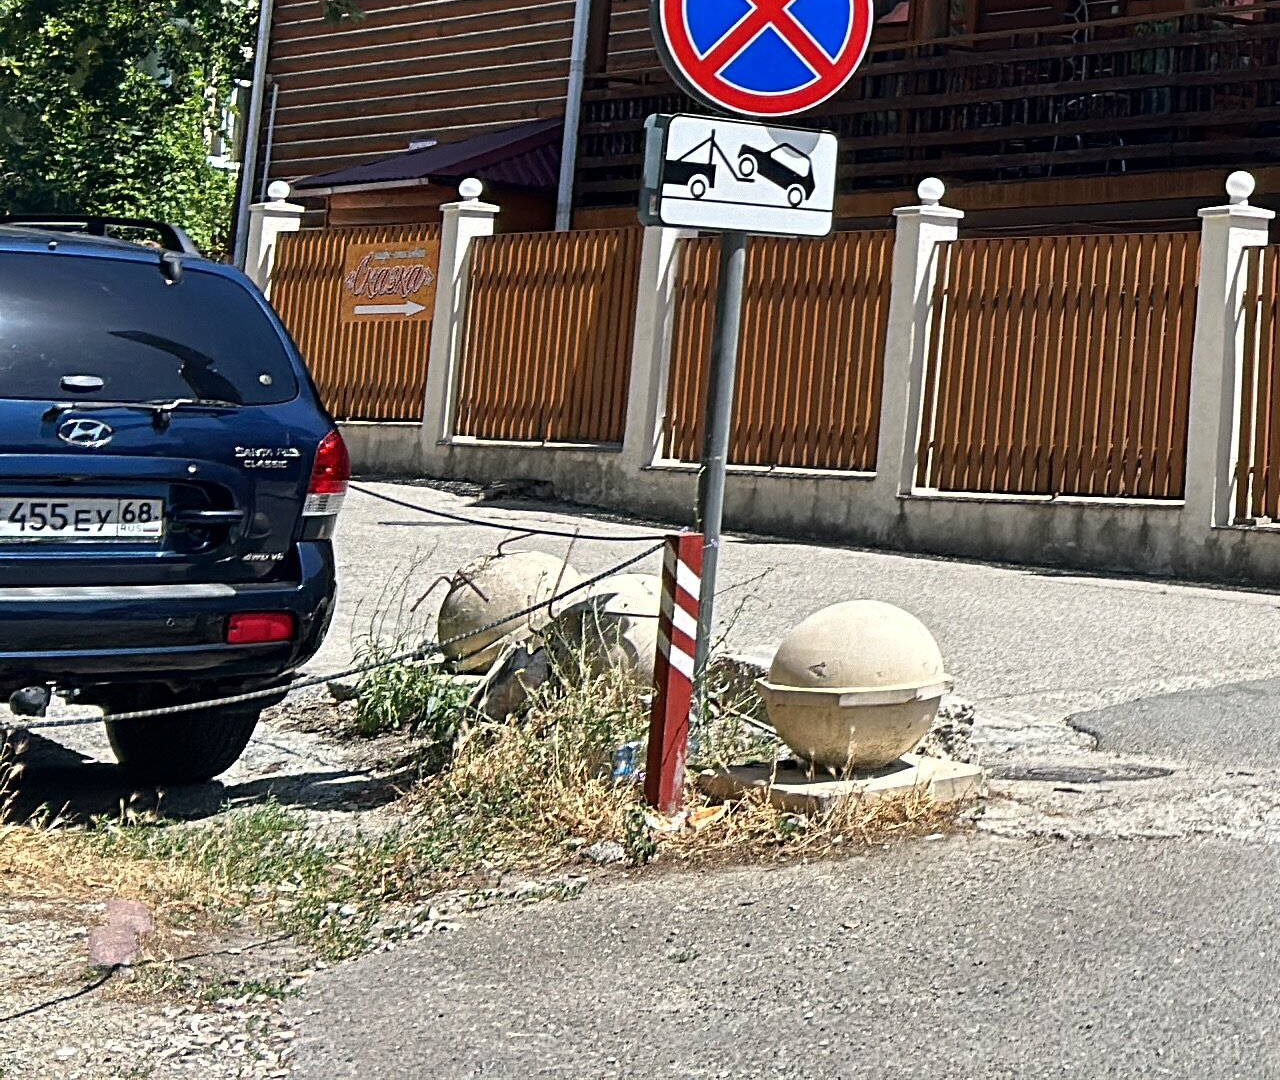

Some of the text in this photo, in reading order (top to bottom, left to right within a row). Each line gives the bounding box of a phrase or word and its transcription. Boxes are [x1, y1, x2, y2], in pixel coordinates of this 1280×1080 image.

[244, 460, 288, 468] CLASSIC
[0, 502, 152, 532] 455ЕУ 68
[120, 524, 142, 532] RUS
